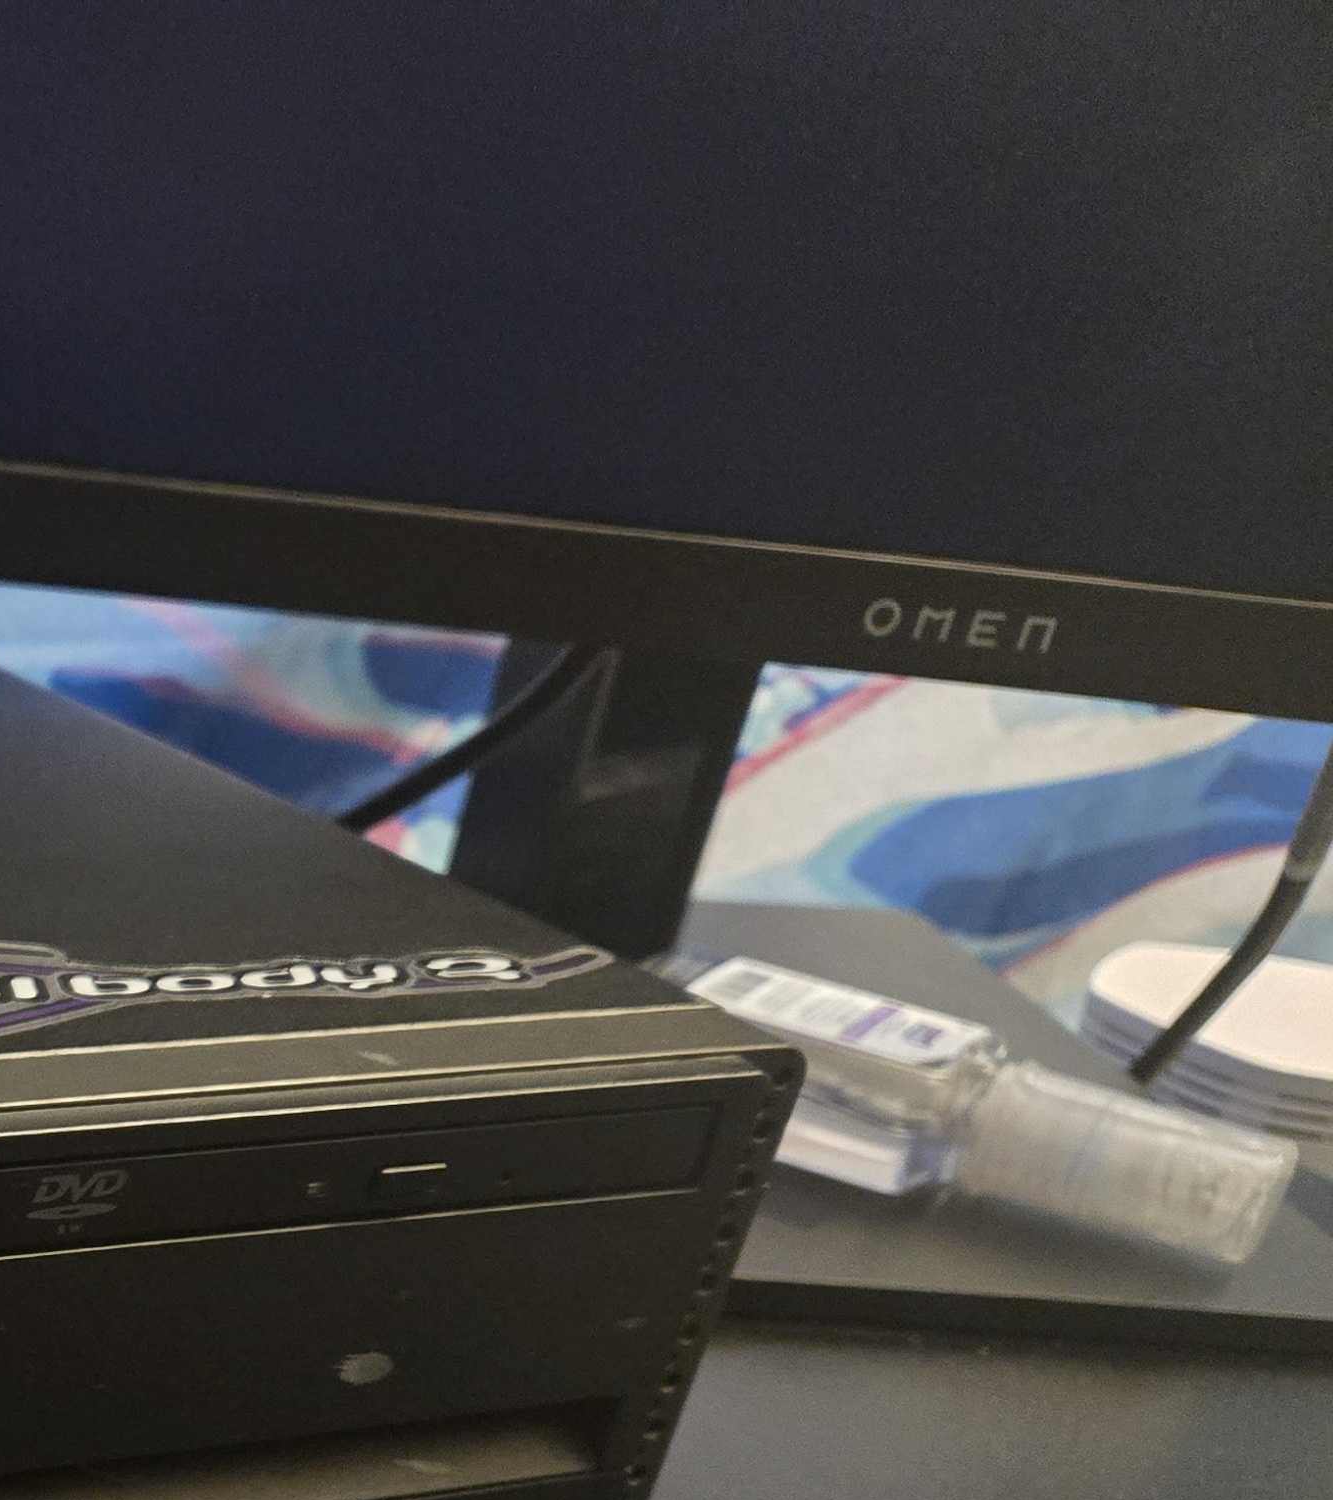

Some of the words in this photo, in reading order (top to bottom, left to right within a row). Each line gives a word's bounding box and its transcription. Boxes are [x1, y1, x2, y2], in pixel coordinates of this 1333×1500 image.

[863, 598, 1057, 654] OMEN
[67, 964, 399, 990] body
[32, 1169, 129, 1203] DVD
